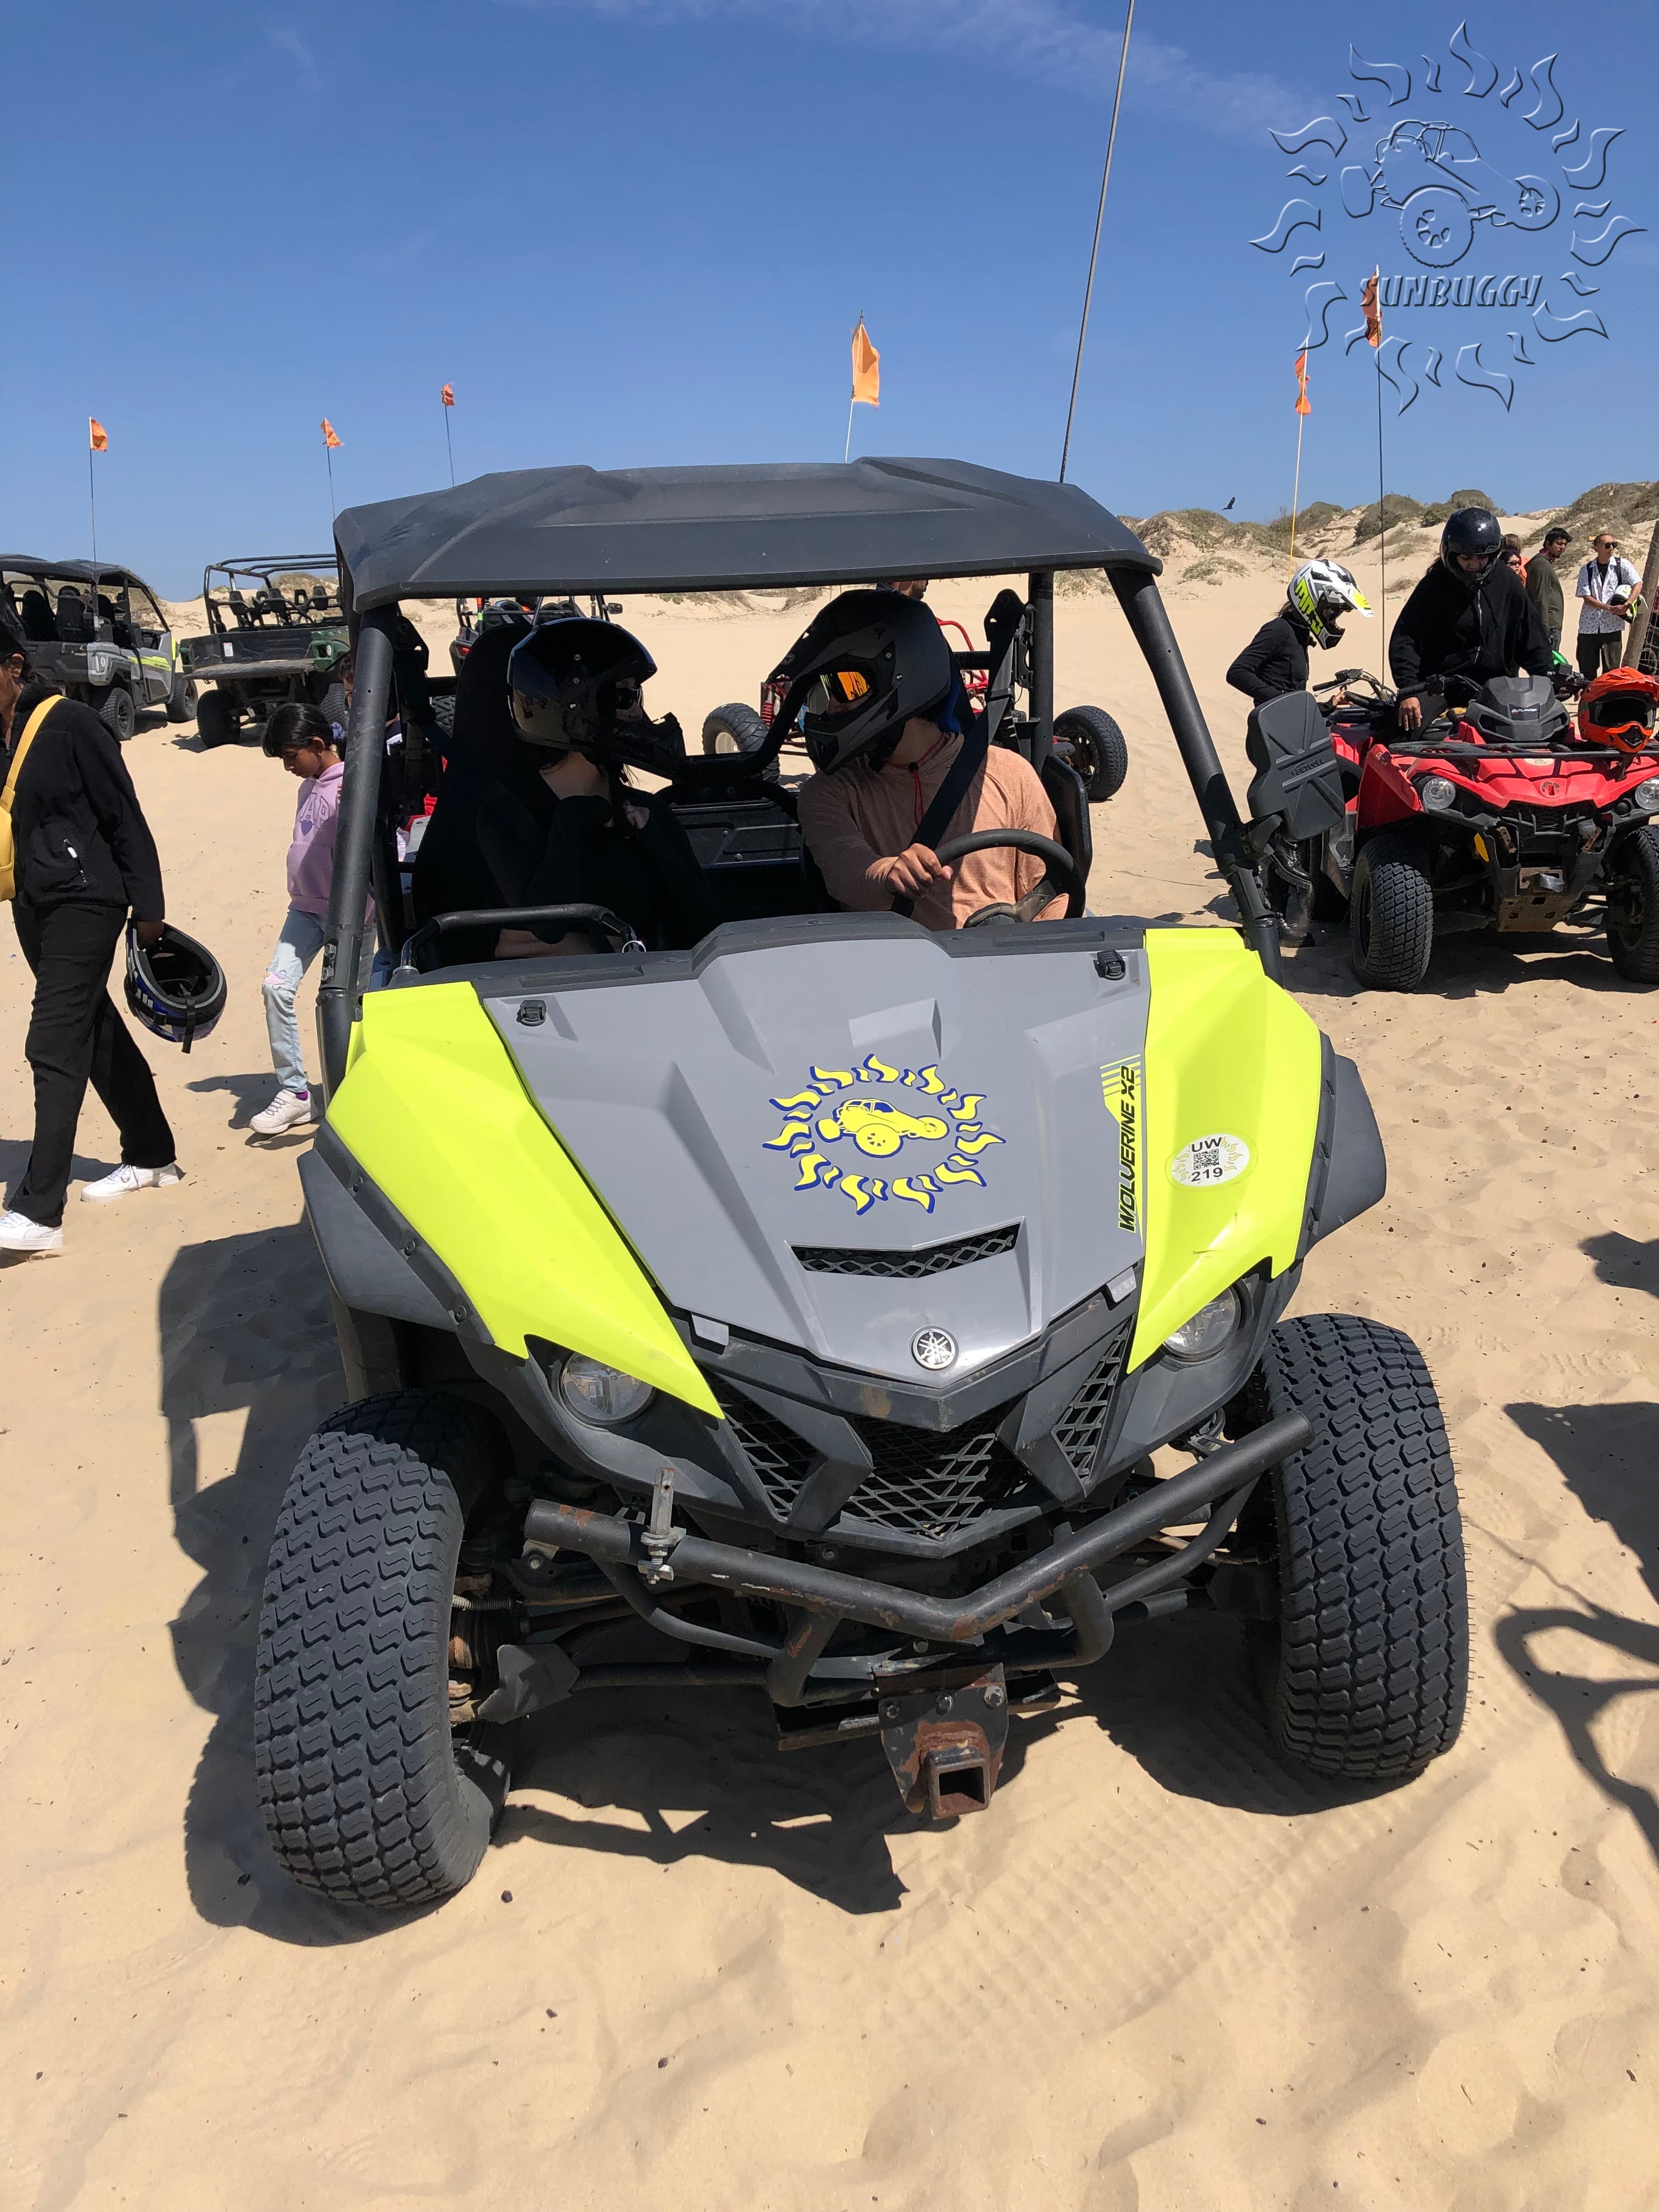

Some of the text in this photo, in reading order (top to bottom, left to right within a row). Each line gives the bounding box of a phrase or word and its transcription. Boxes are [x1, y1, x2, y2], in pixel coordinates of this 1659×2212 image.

[1119, 1065, 1135, 1232] WOLVERINE X2
[1192, 1137, 1222, 1152] UW
[1191, 1167, 1223, 1182] 219
